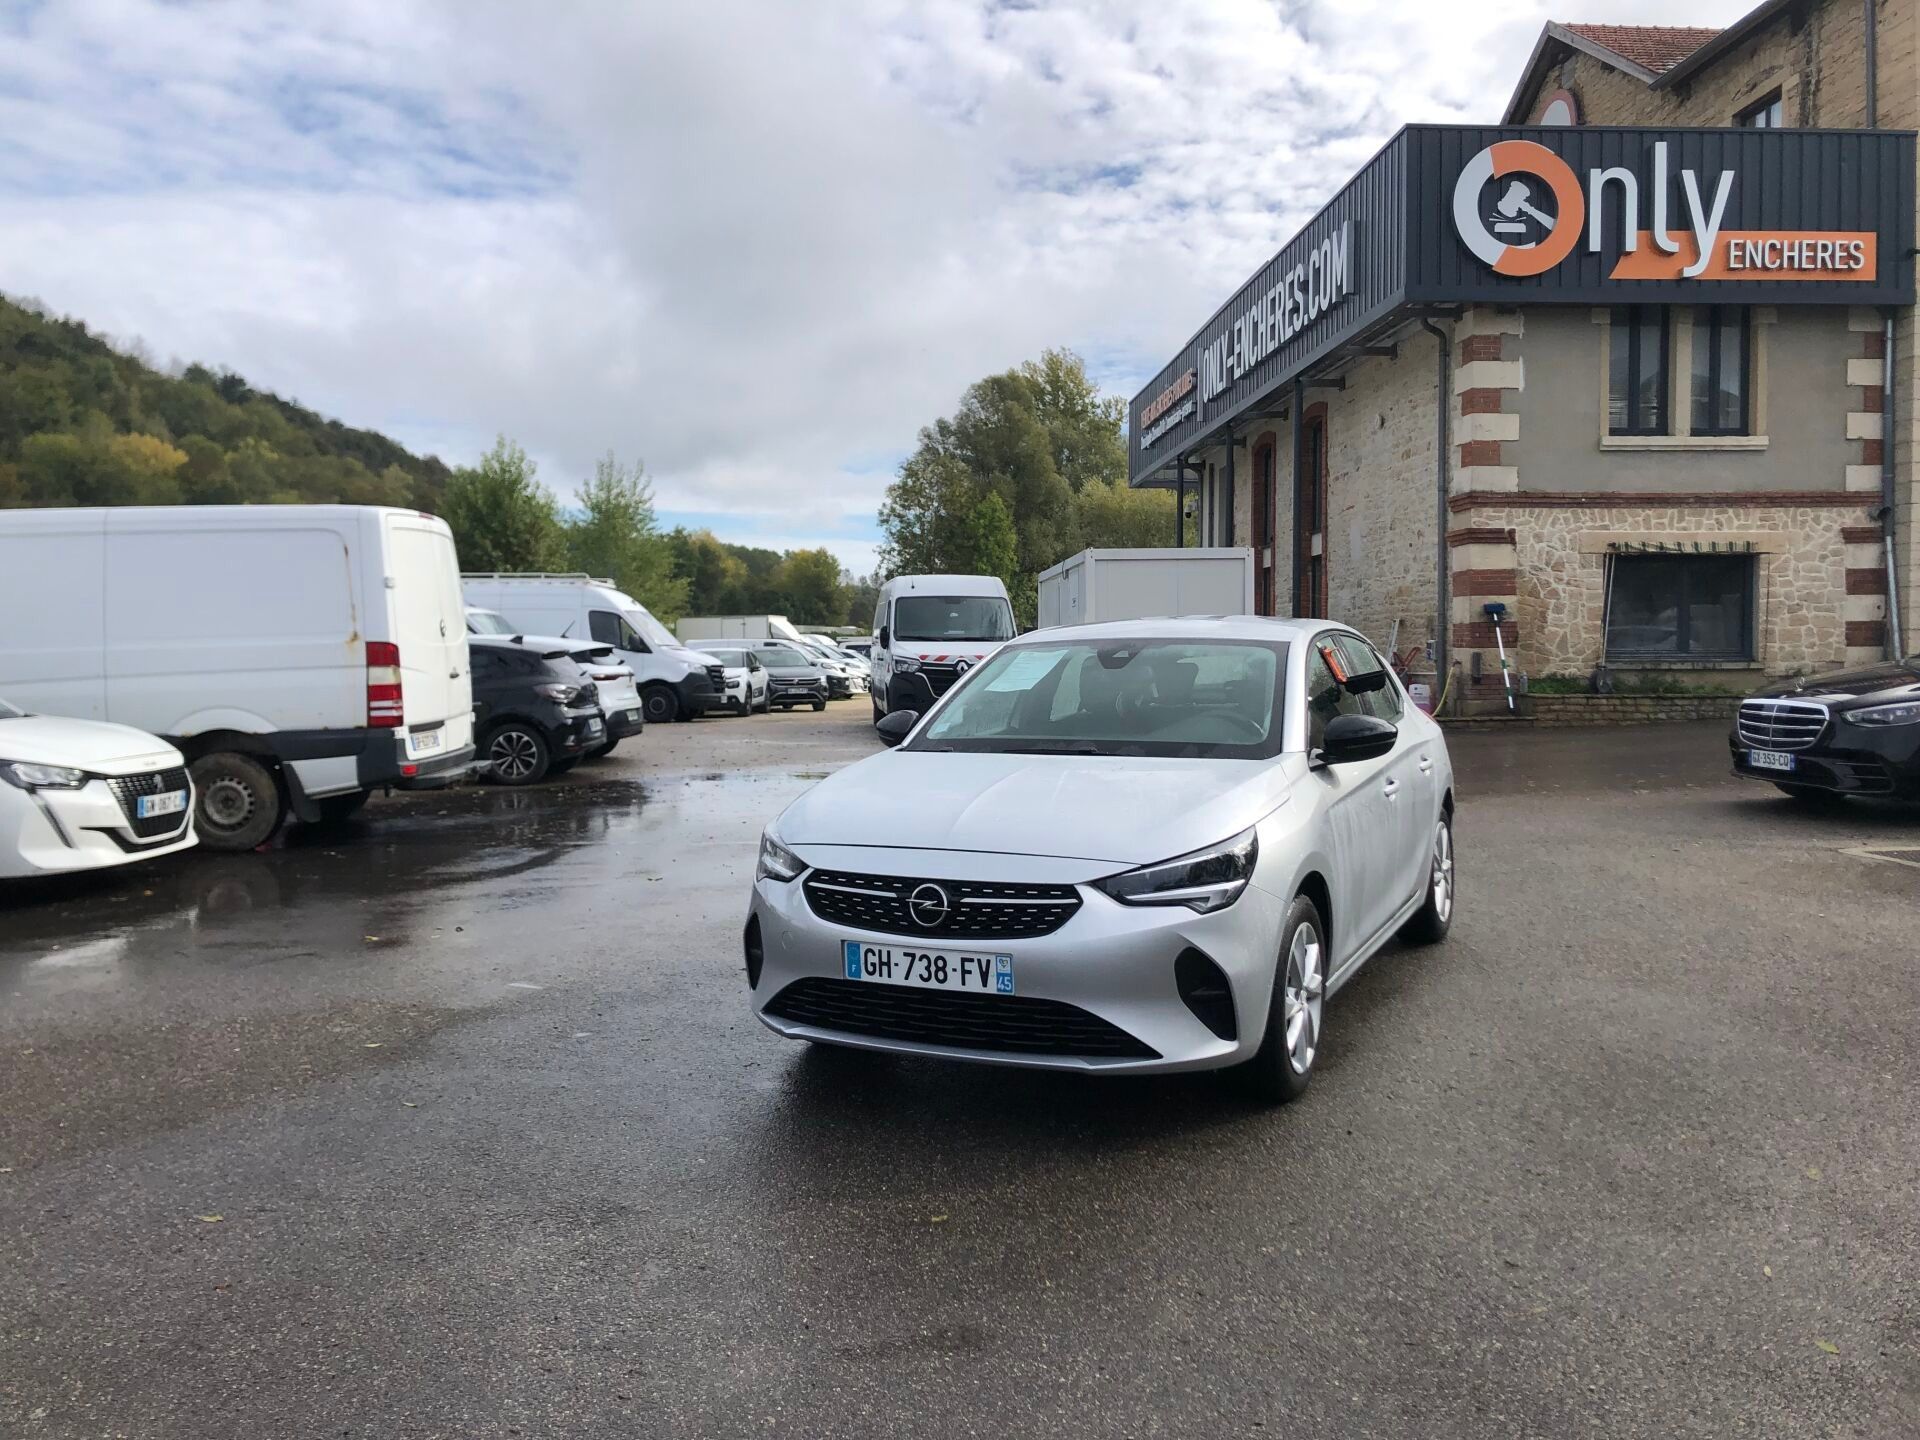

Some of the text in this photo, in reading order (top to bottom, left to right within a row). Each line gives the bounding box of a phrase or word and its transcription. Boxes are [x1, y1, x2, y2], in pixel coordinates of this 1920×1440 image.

[1453, 140, 1736, 278] Only
[1729, 239, 1865, 269] ENCHERES
[1202, 220, 1350, 404] ONLY-ENCHERES.COM
[851, 947, 1012, 991] F GH-738-FV 45
